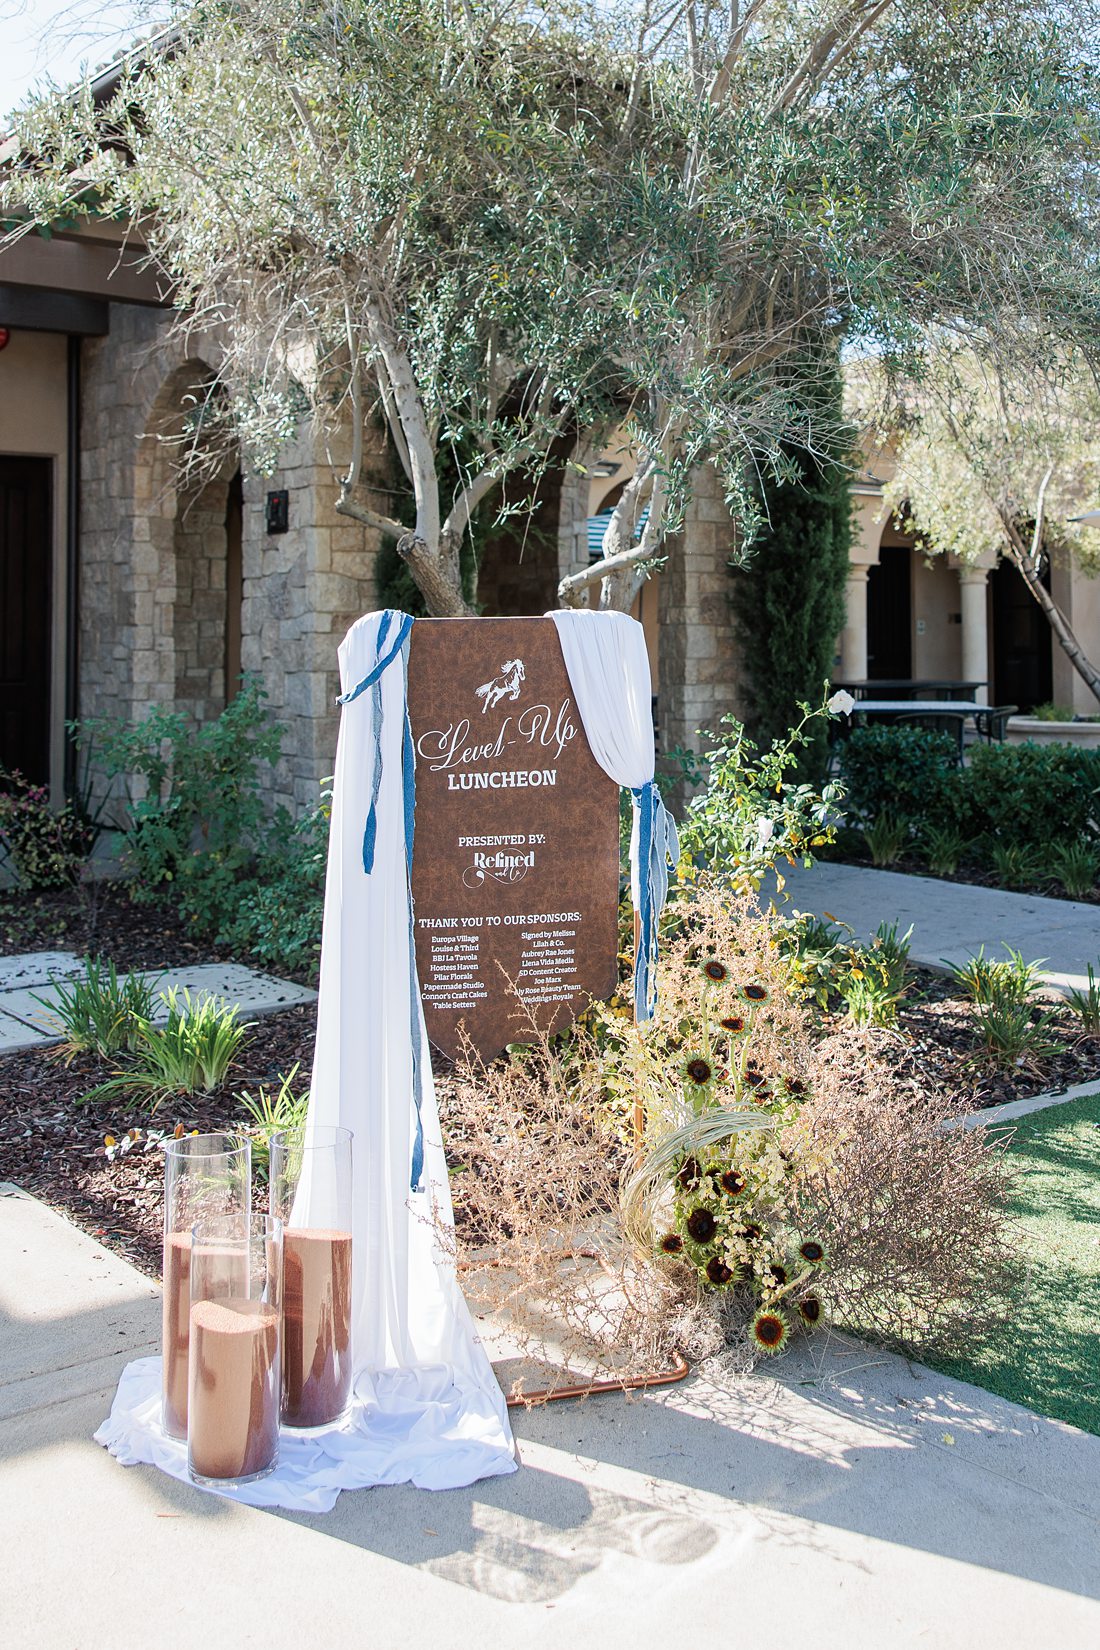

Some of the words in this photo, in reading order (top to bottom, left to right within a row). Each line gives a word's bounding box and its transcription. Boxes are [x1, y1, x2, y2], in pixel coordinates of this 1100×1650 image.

[448, 770, 556, 790] LUNCHEON
[458, 834, 525, 847] PRESENTED
[528, 833, 546, 844] BY:
[474, 850, 535, 868] Refined
[418, 918, 459, 929] THANK
[460, 917, 484, 927] YOU
[485, 916, 502, 926] TO
[503, 915, 527, 925] OUR
[527, 912, 582, 924] SPONSORS:
[431, 936, 456, 944] Europa
[456, 934, 479, 943] Village
[521, 932, 544, 940] Signed
[544, 931, 552, 939] by
[552, 929, 576, 937] Melissa
[431, 945, 454, 953] Louise
[460, 944, 480, 952] Third
[521, 951, 545, 959] Aubrey
[557, 948, 575, 956] Jones
[540, 958, 555, 966] Vida
[554, 957, 575, 965] Media
[430, 964, 457, 972] Hostess
[519, 969, 529, 977] SD
[529, 967, 554, 975] Content
[554, 966, 577, 974] Creator
[433, 973, 450, 981] Pilar
[450, 972, 473, 980] Florals
[534, 977, 545, 985] Joe
[545, 976, 562, 984] Marx
[423, 982, 463, 992] Papermade
[462, 981, 485, 990] Studio
[525, 986, 541, 994] Rose
[541, 985, 562, 993] Beauty
[562, 983, 582, 991] Team
[421, 992, 452, 1001] Connor's
[451, 991, 470, 999] Craft
[469, 990, 488, 998] Cakes
[552, 992, 574, 1002] Royale
[432, 1001, 452, 1010] Table
[452, 1000, 477, 1009] Setters
